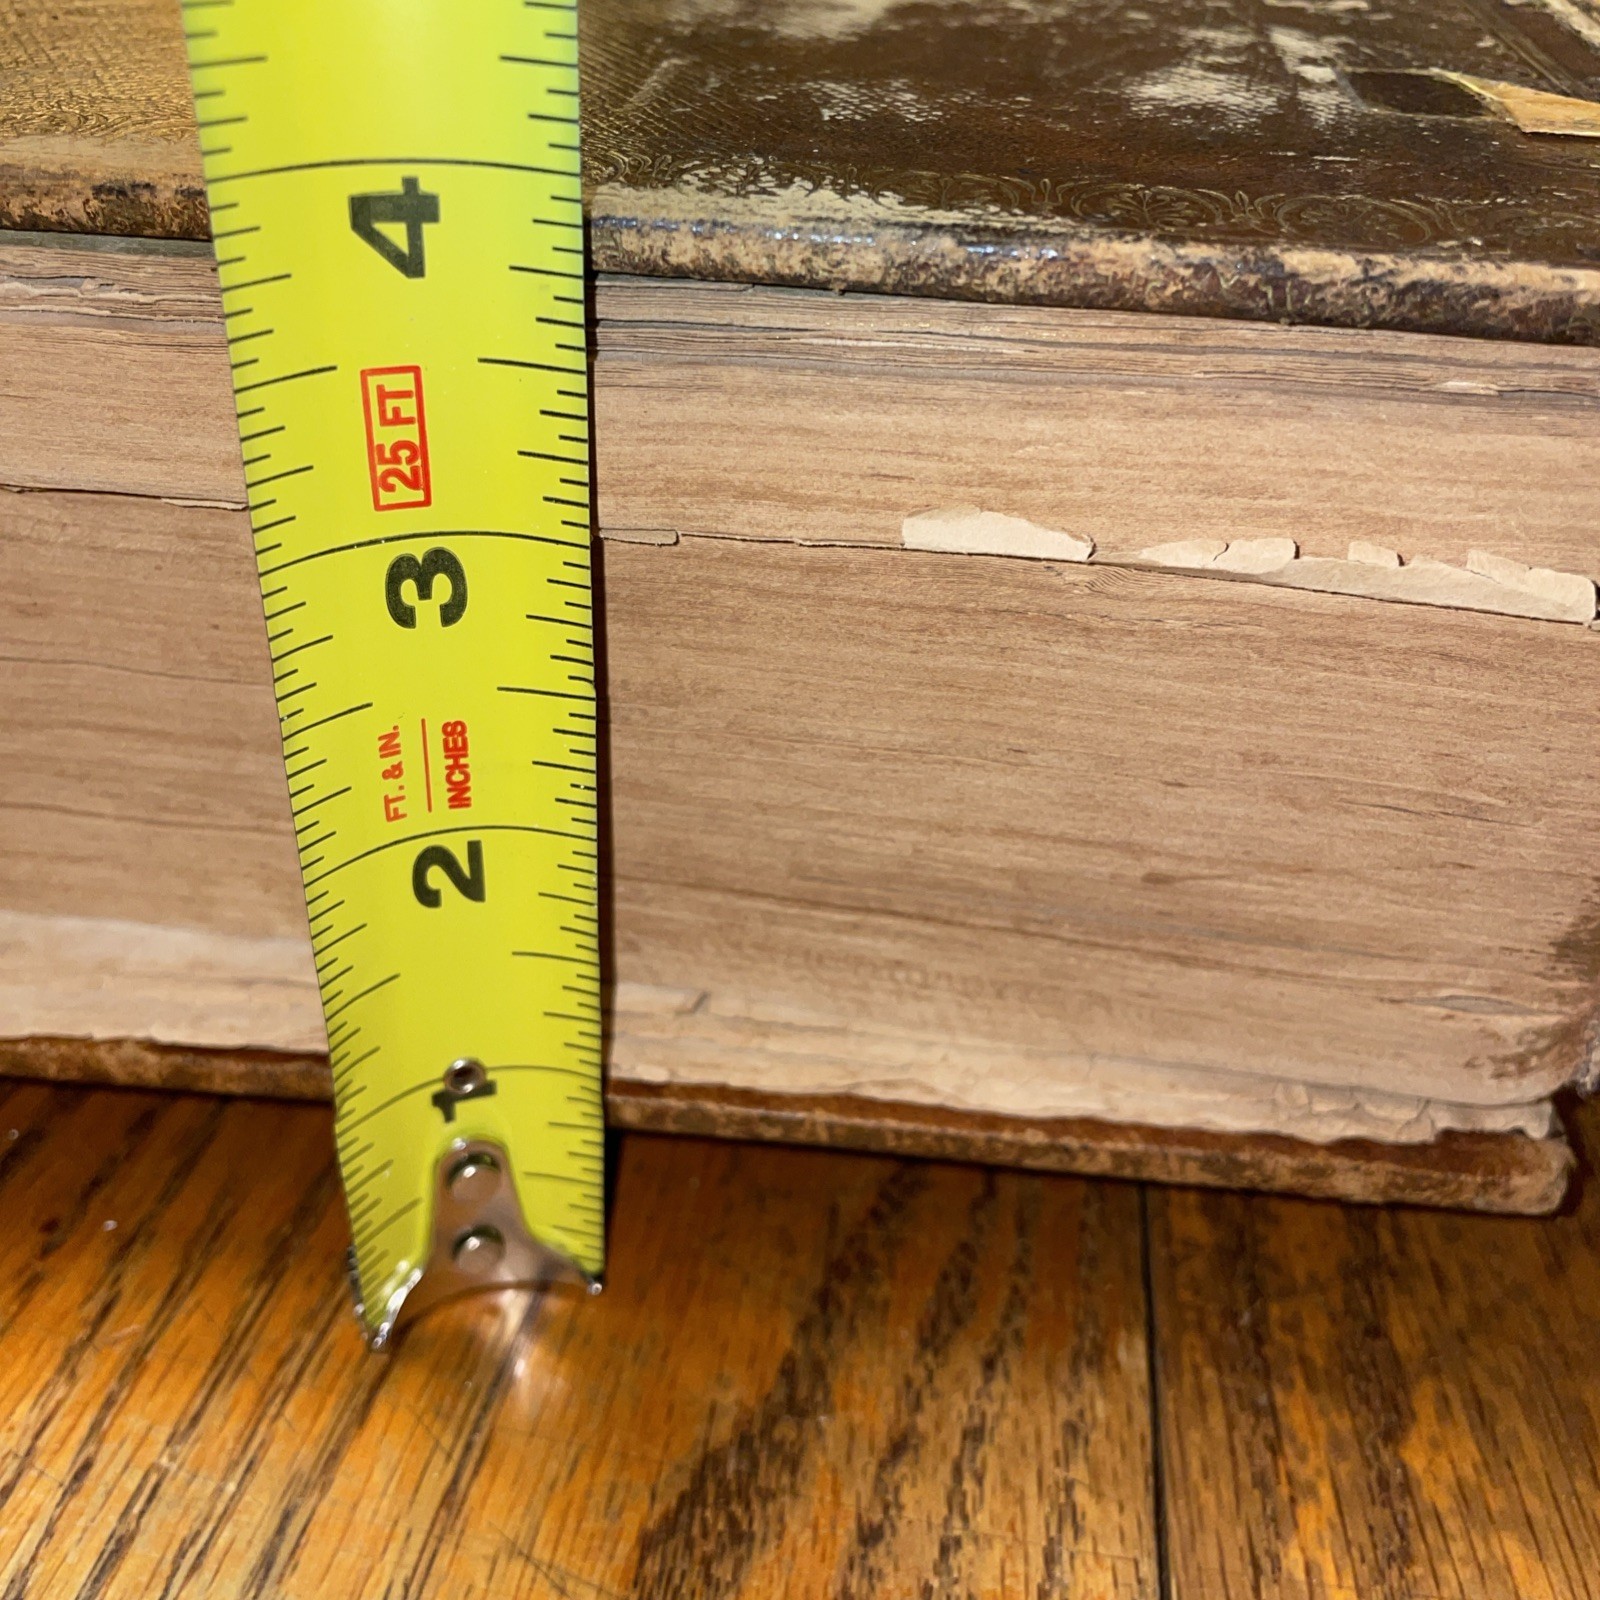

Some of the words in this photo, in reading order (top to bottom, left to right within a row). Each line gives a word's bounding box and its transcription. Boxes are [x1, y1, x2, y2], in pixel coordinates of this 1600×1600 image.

[348, 176, 440, 279] 4
[376, 383, 416, 427] FT
[377, 440, 422, 493] 25
[385, 546, 468, 629] 3
[377, 725, 403, 760] IN.
[441, 720, 472, 810] INCHES
[381, 761, 405, 781] &
[383, 785, 408, 823] FT.
[412, 840, 486, 909] 2
[431, 1079, 498, 1124] 1
